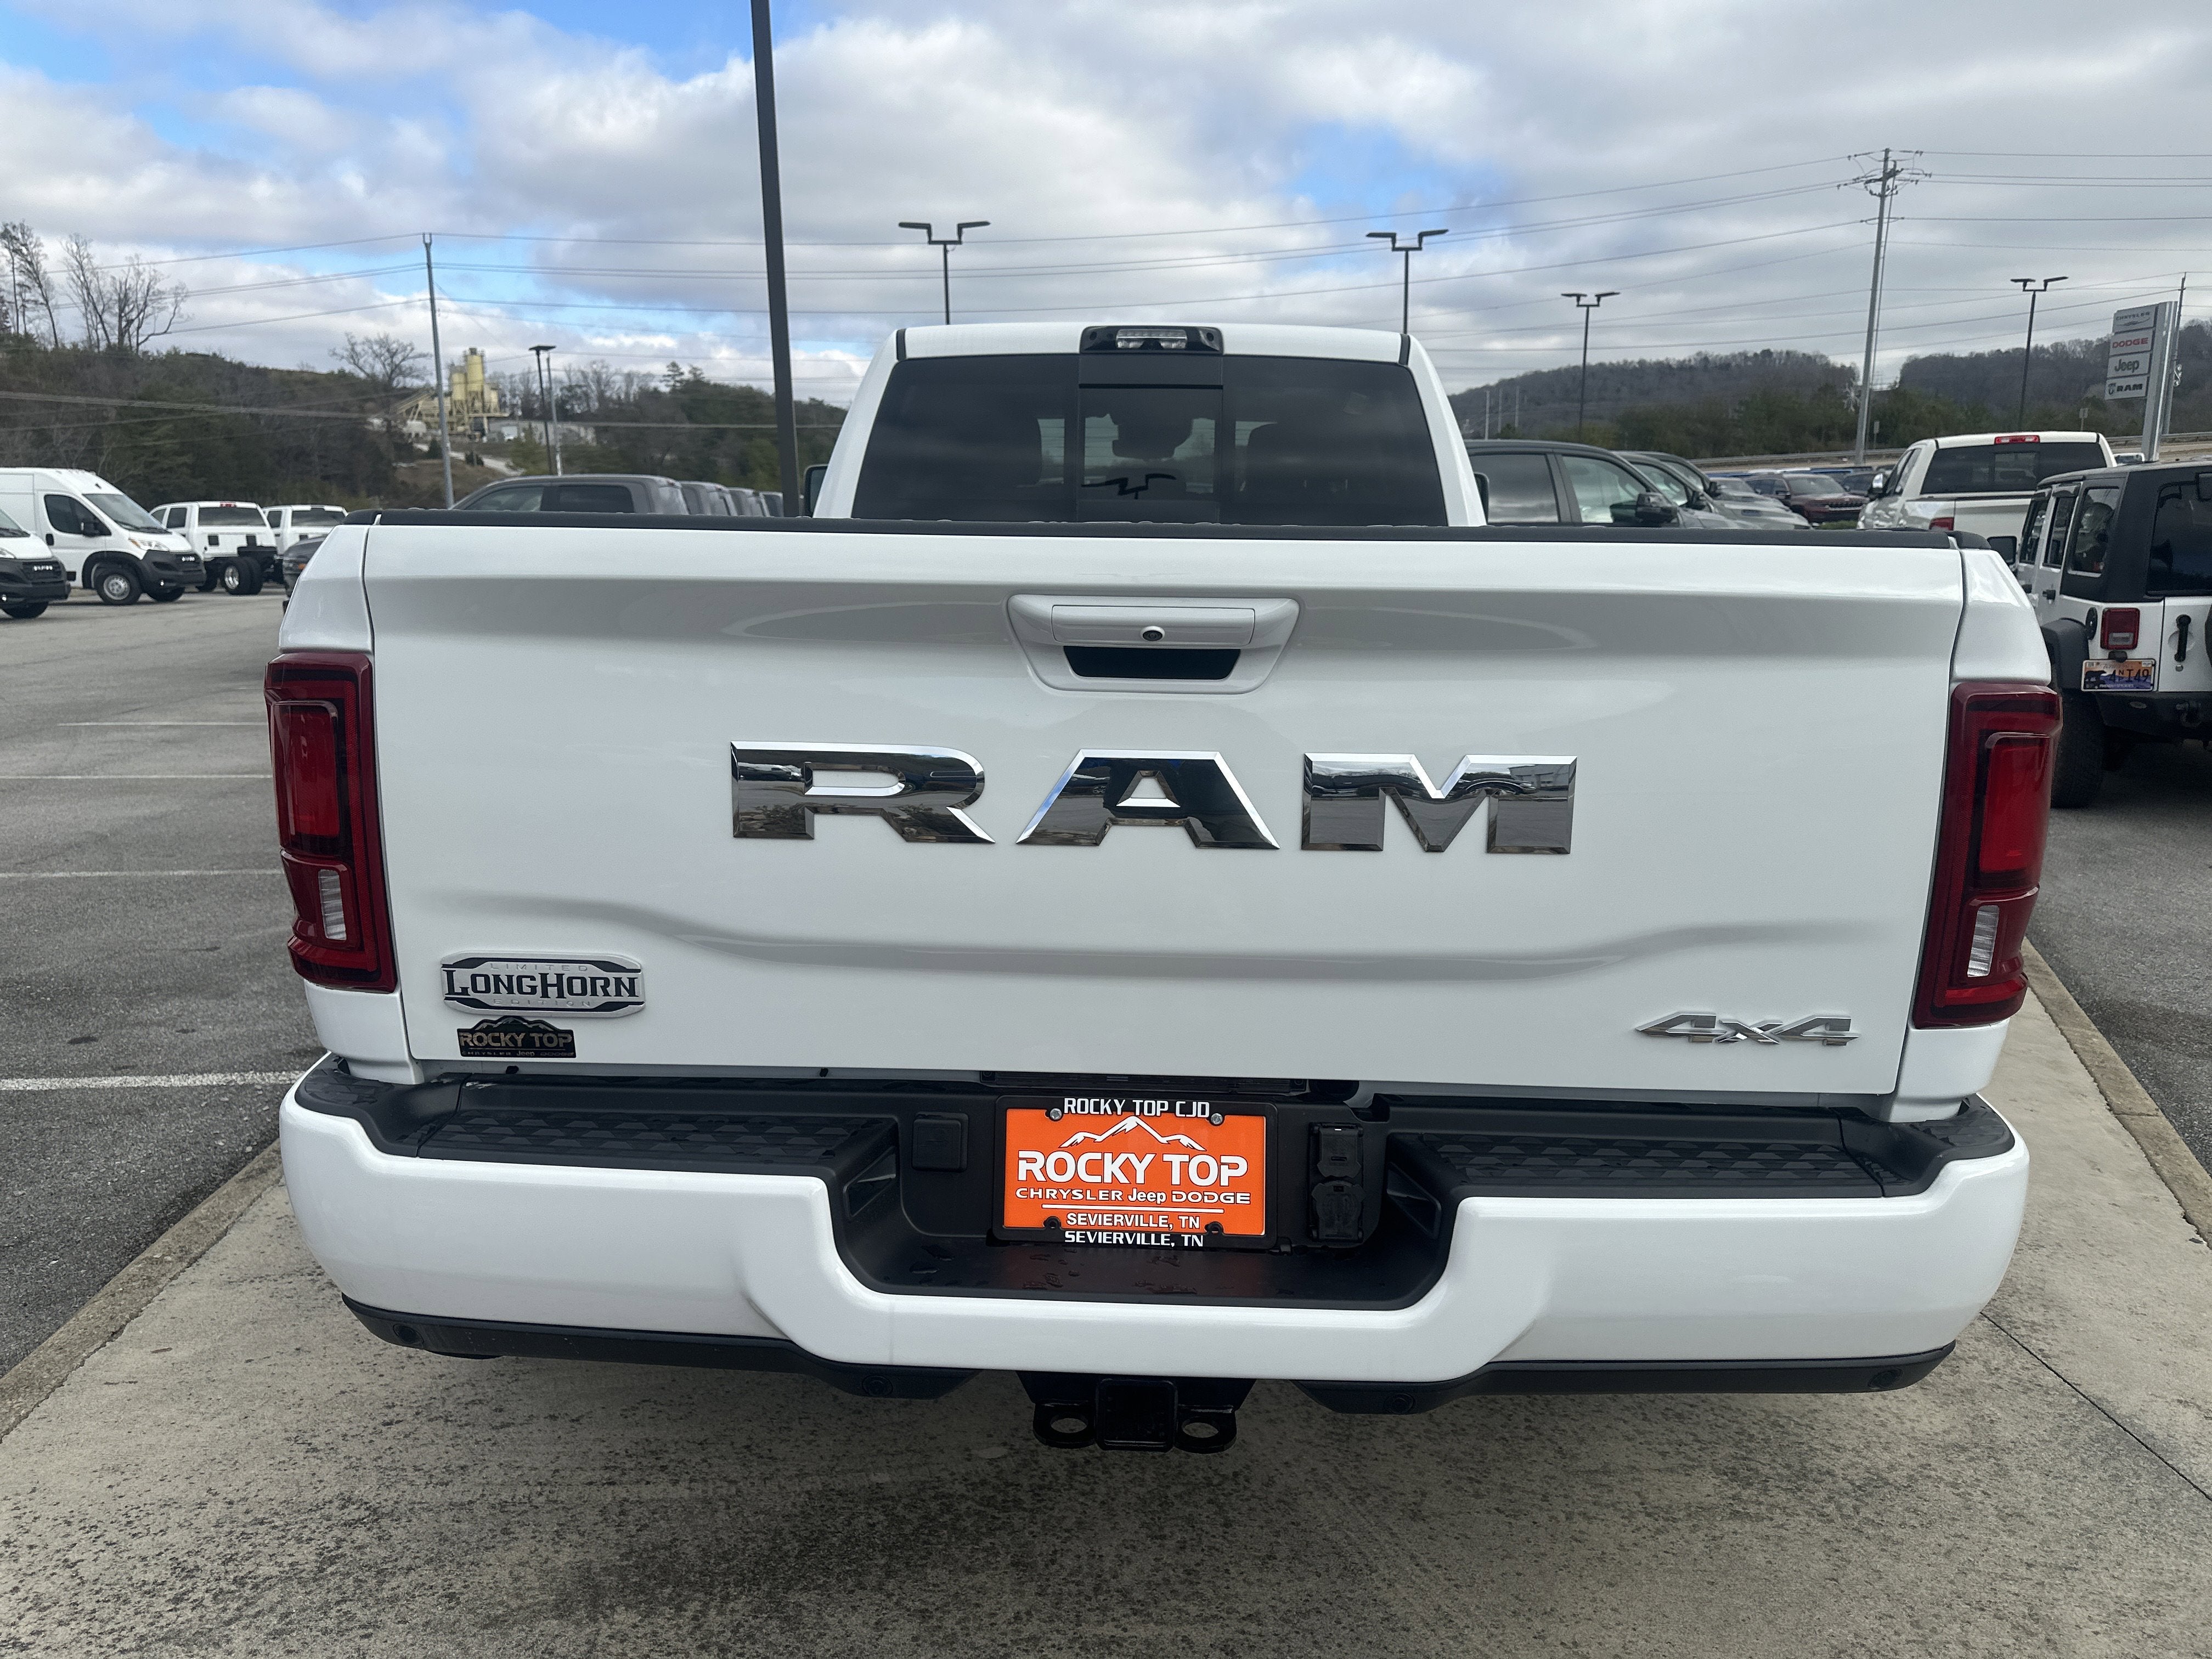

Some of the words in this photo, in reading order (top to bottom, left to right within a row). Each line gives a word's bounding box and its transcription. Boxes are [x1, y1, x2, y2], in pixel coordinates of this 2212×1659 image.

[2115, 312, 2150, 320] CHRYSLER
[2112, 337, 2148, 348] DODGE
[2114, 359, 2140, 373] Jeep
[730, 741, 1578, 855] RAM
[490, 963, 589, 972] LIMITED
[493, 998, 591, 1007] EDITION
[459, 1032, 524, 1047] ROCKY
[529, 1032, 572, 1047] TOP
[1064, 1098, 1126, 1116] ROCKY
[1132, 1100, 1169, 1117] TOP
[1175, 1101, 1210, 1119] CJD
[1017, 1150, 1156, 1184] ROCKY
[1163, 1153, 1249, 1187] TOP
[1015, 1187, 1123, 1201] CHRYSLER
[1128, 1188, 1166, 1204] Jeep
[1172, 1190, 1251, 1204] DODGE
[1066, 1212, 1173, 1230] SEVIERVILLE,
[1179, 1215, 1200, 1229] TN
[1065, 1231, 1176, 1247] SEVIERVILLE,
[1182, 1234, 1204, 1247] TN
